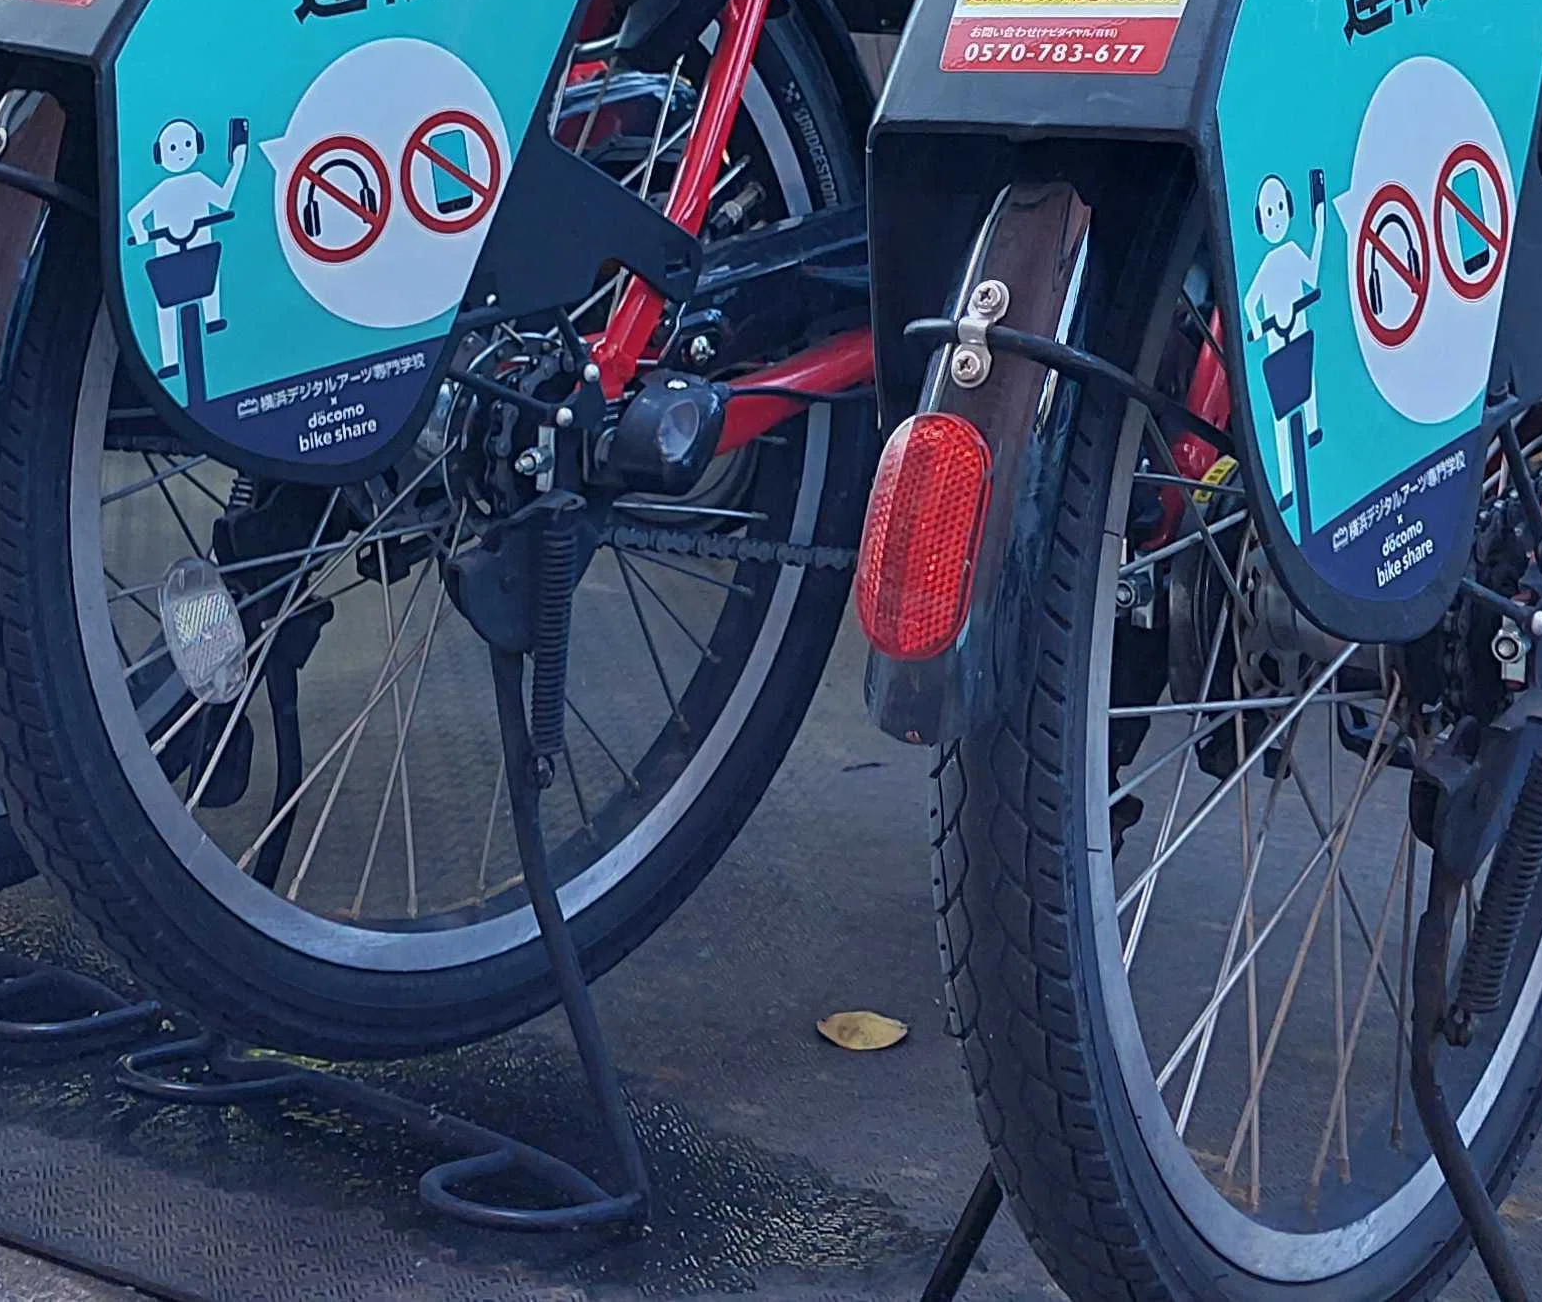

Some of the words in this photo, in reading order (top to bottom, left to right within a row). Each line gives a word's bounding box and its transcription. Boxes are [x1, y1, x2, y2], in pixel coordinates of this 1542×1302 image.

[964, 43, 1146, 65] 0570-783-677
[793, 107, 839, 210] BRIDGESTON
[260, 352, 426, 413] 横浜デジタルアーツ専門学校
[299, 432, 332, 453] bike
[334, 419, 377, 442] share
[308, 403, 365, 429] docomo
[1349, 450, 1466, 541] 横浜デジタルアーツ専門学校
[1382, 520, 1423, 557] docomo
[1376, 559, 1402, 587] bike
[1402, 539, 1434, 569] share
